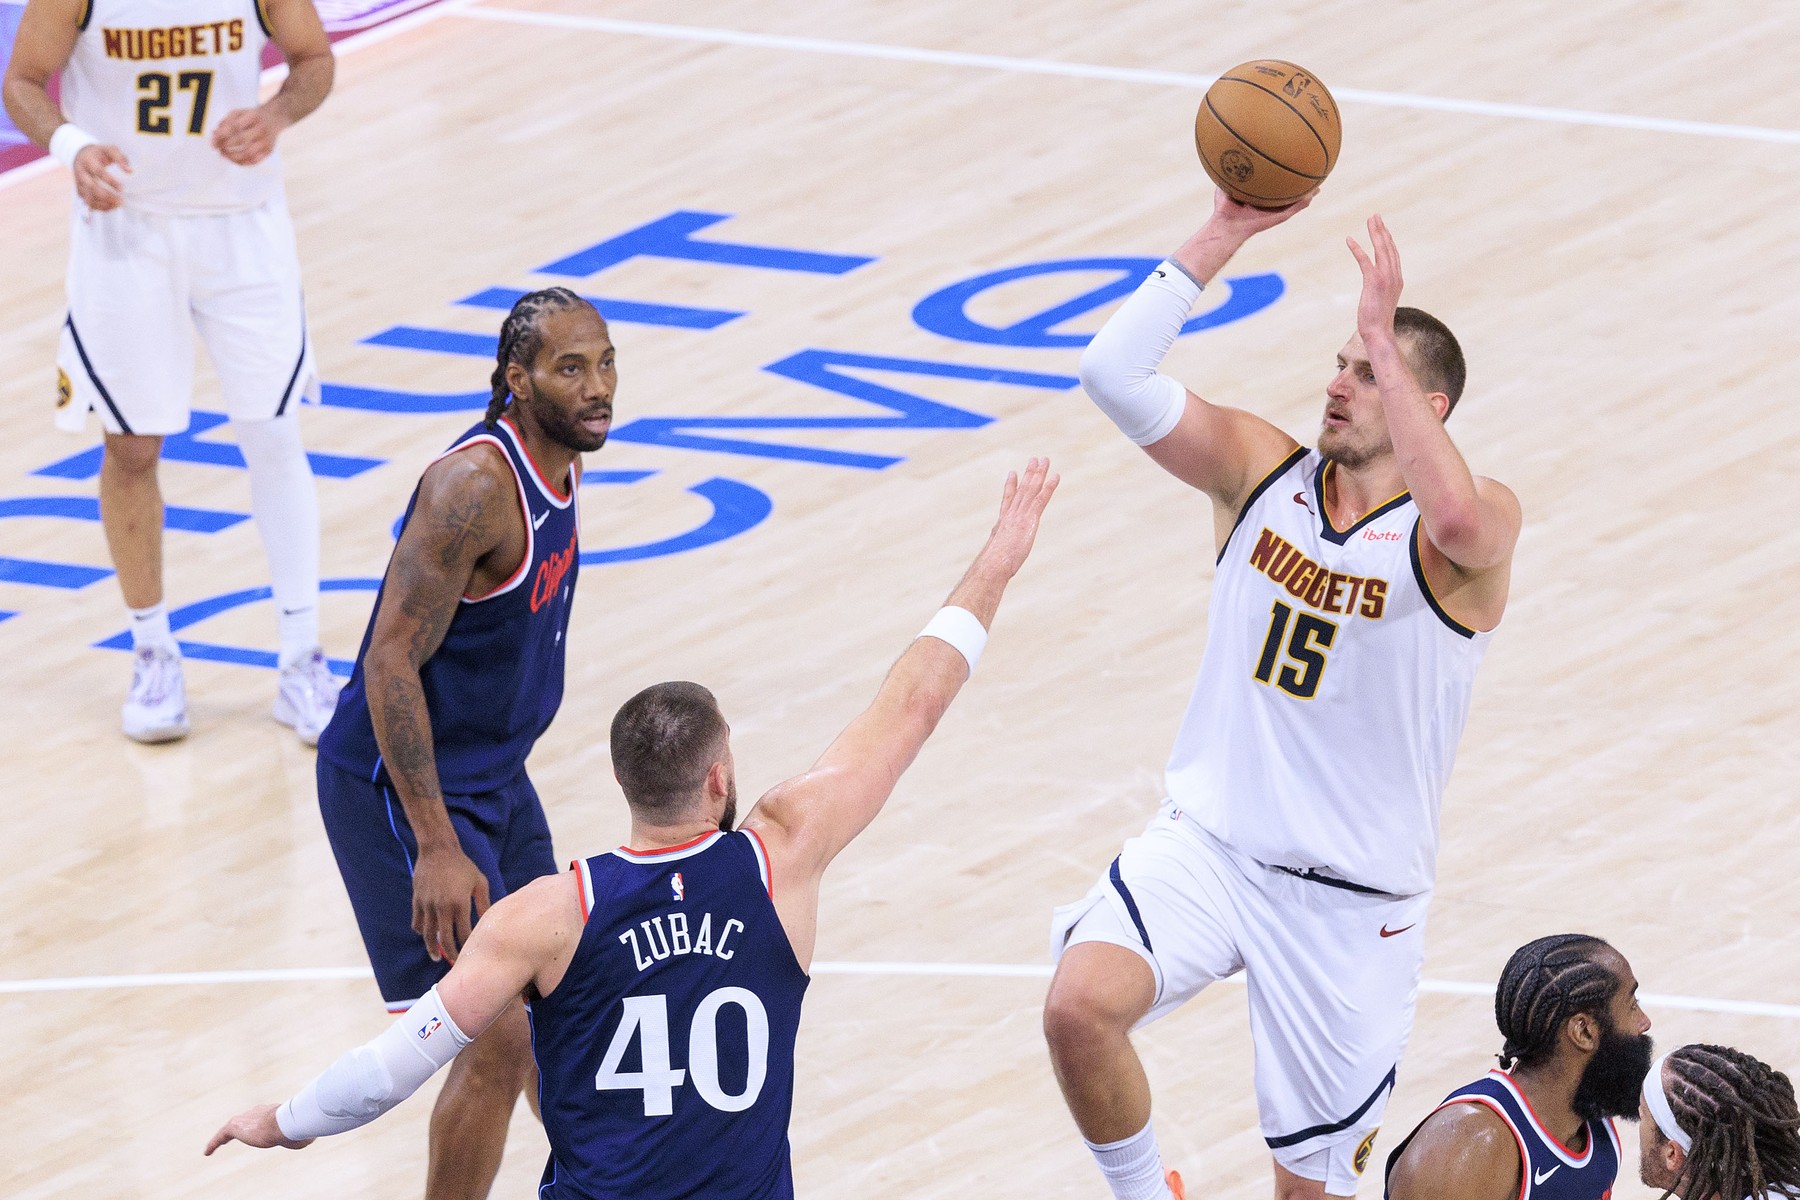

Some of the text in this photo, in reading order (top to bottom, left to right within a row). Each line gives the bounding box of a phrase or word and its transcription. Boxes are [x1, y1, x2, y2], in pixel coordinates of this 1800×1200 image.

[102, 18, 244, 61] NUGGETS
[135, 69, 213, 136] 27
[1249, 527, 1389, 621] NUGGETS
[1252, 598, 1339, 700] 15
[618, 912, 744, 972] ZUBAC
[595, 986, 770, 1117] 40
